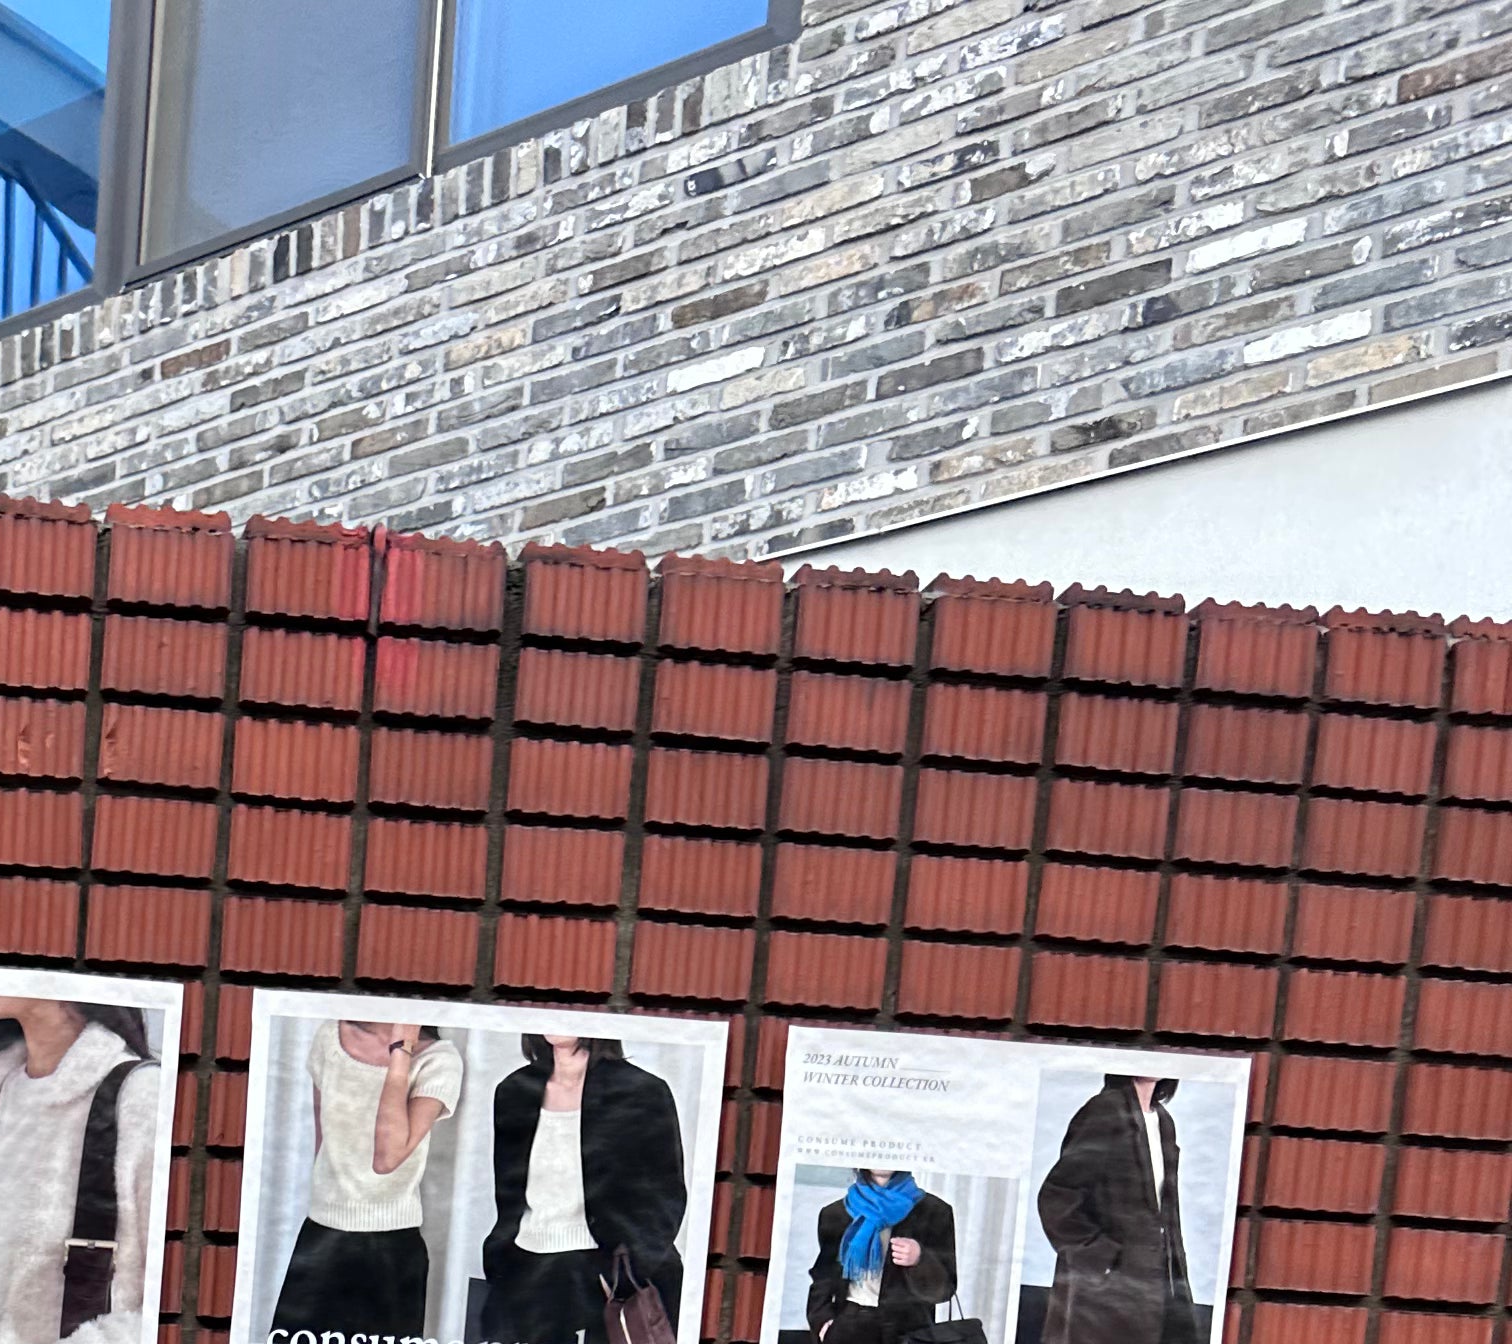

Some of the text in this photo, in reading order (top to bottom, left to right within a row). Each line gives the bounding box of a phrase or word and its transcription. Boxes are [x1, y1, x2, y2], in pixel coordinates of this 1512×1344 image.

[803, 1052, 900, 1070] 2023 AUTUMN
[803, 1071, 951, 1093] WINTER COLLECTION
[797, 1135, 922, 1151] CONSUME PRODUCT
